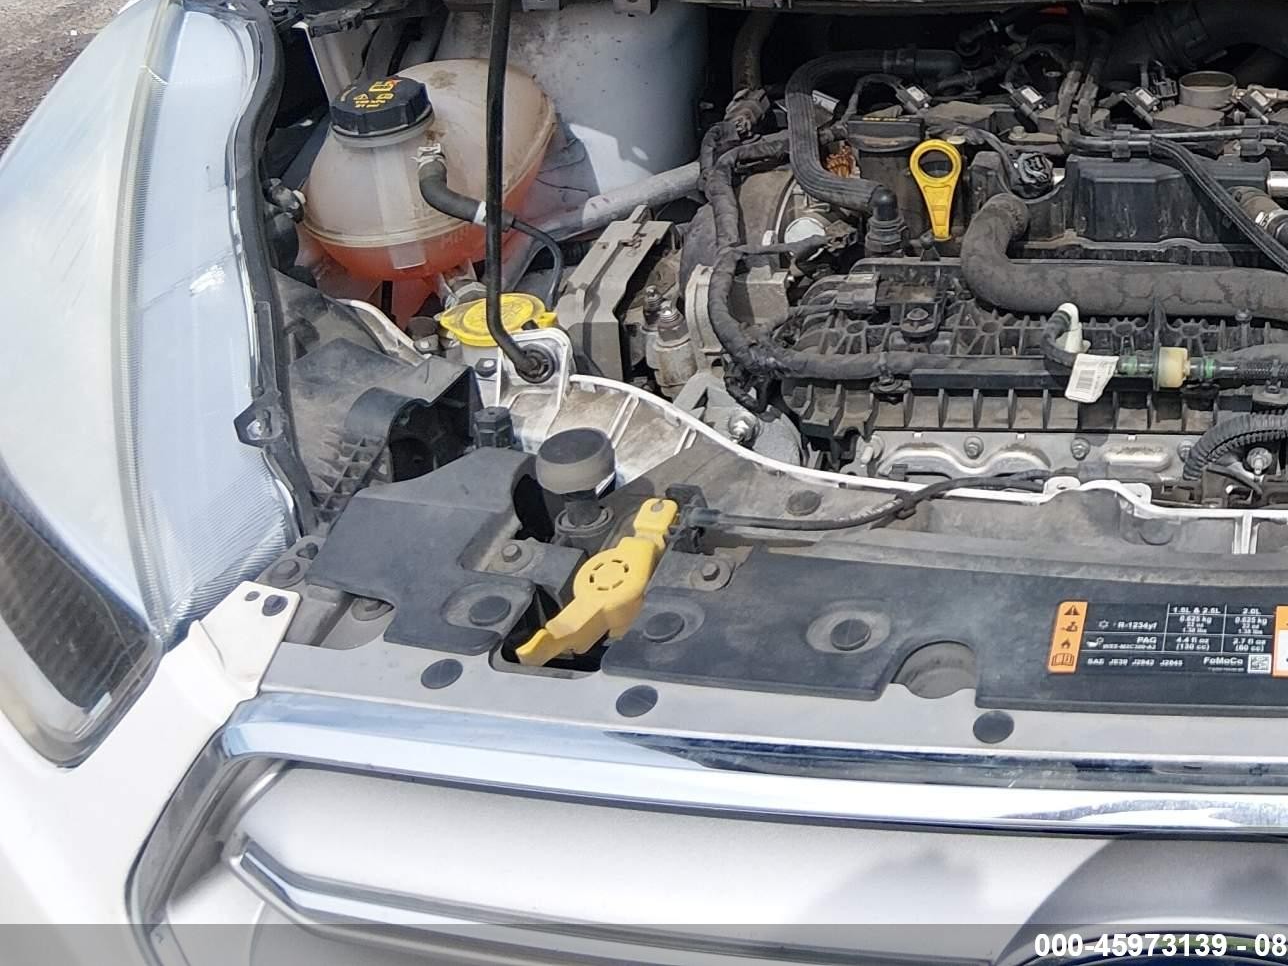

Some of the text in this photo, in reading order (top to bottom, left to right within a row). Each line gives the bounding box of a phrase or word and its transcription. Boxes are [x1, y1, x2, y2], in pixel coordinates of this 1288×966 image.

[1193, 607, 1201, 615] &
[1242, 607, 1262, 615] 2.0L
[1117, 621, 1158, 632] R-1234yf
[1136, 636, 1157, 644] PAG
[1175, 636, 1189, 644] 4.4
[1202, 656, 1244, 666] FoMoCo
